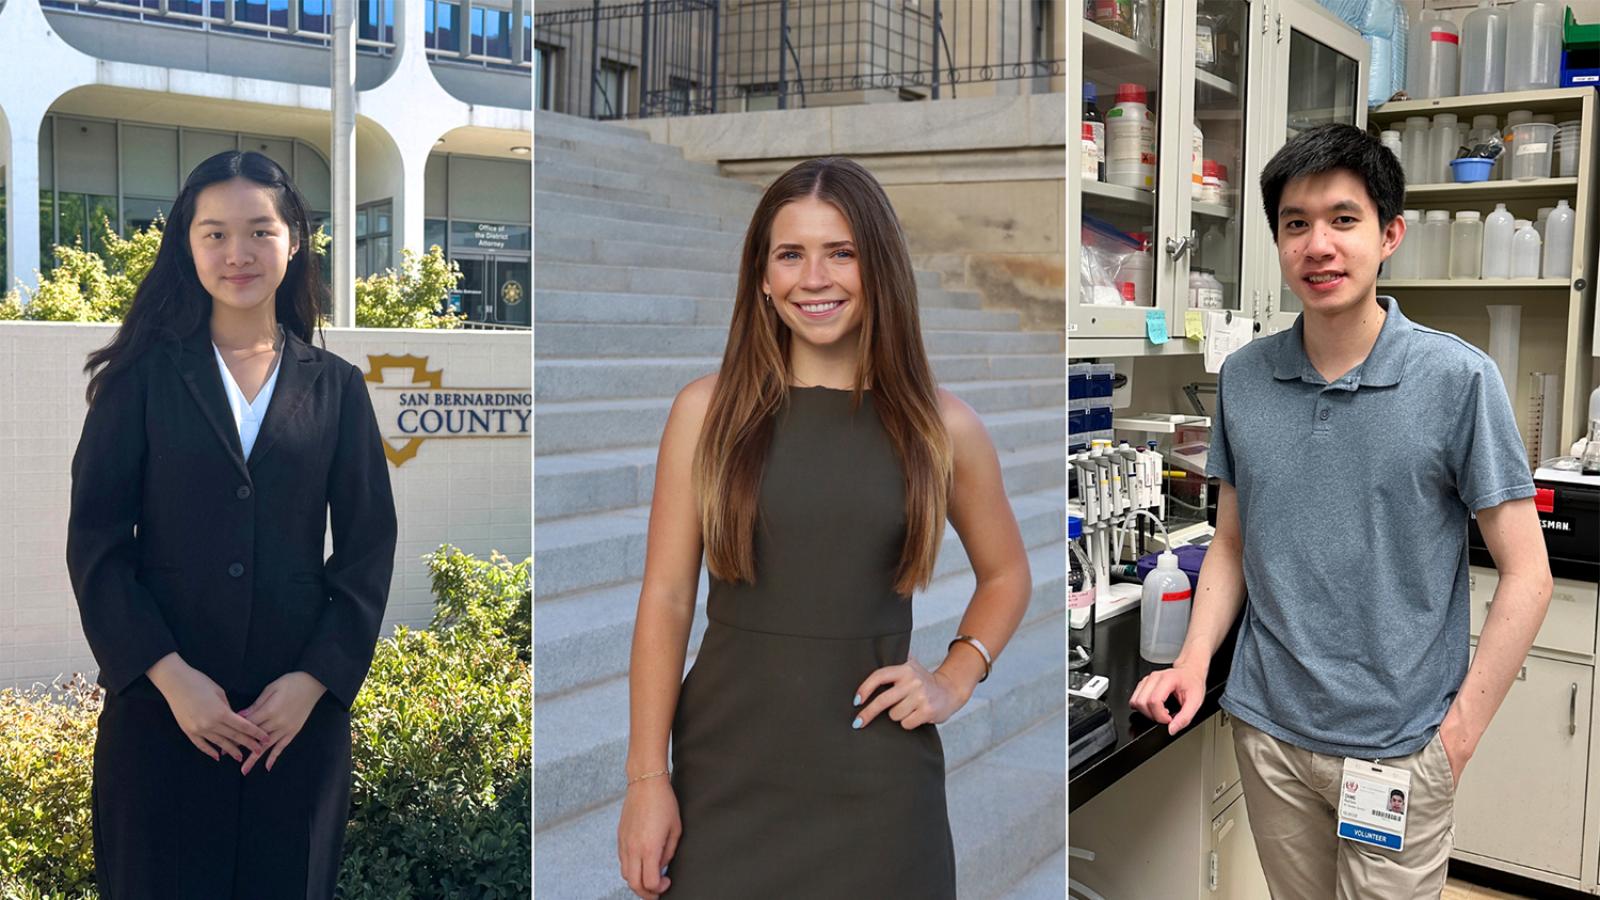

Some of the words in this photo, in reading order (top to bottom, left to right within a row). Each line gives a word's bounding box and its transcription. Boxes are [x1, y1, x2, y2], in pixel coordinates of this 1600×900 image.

[478, 223, 497, 232] Office
[485, 232, 509, 240] District
[478, 239, 505, 248] Attorney
[399, 393, 430, 406] SAN
[434, 393, 532, 406] BERNARDINO
[397, 409, 532, 433] COUNTY
[1354, 829, 1387, 843] VOLUNTEER
